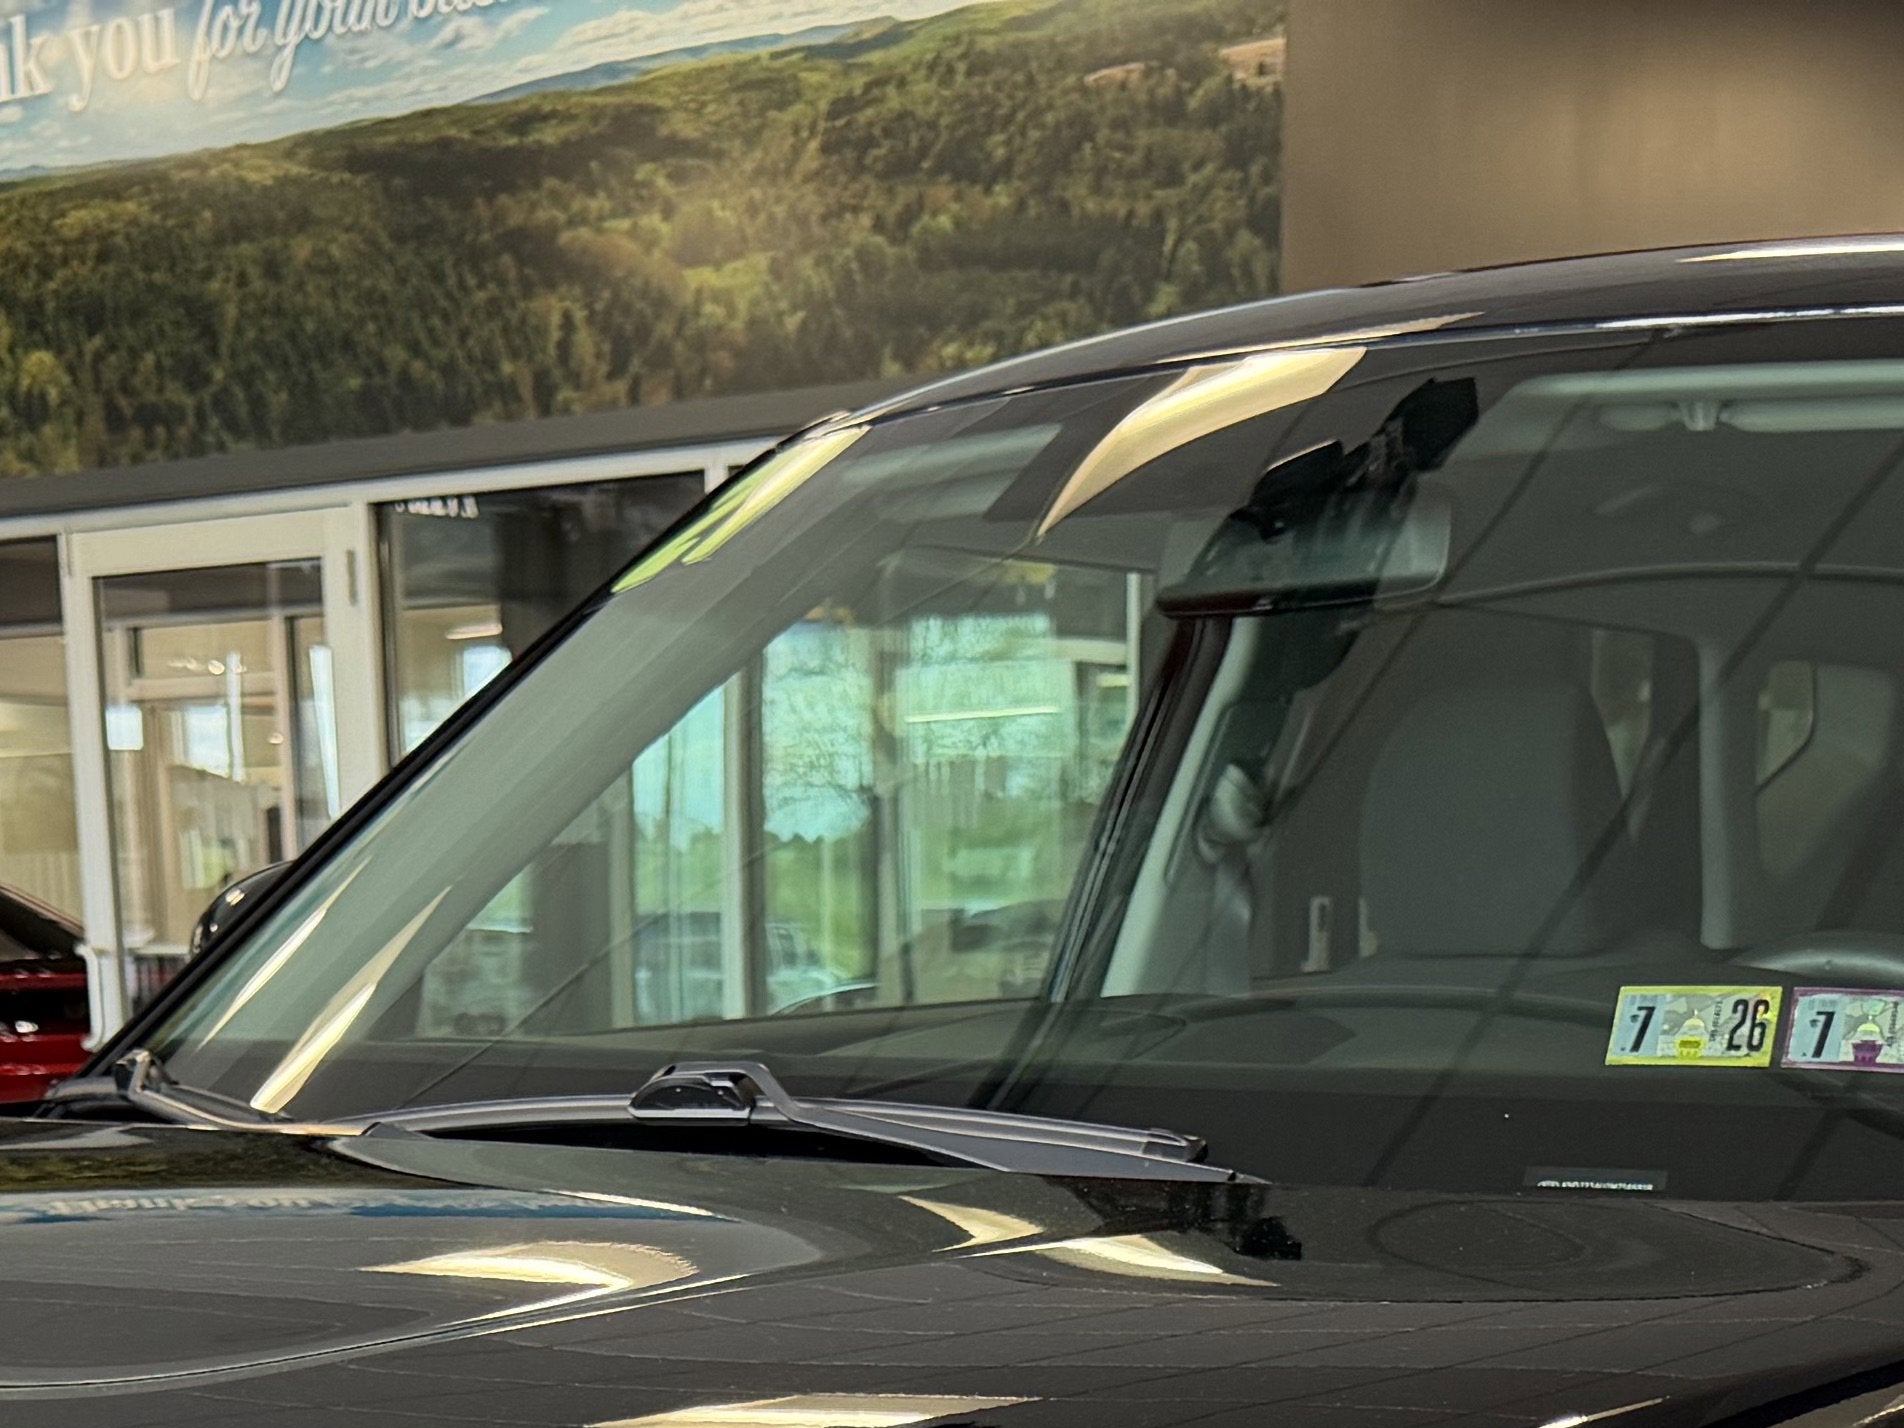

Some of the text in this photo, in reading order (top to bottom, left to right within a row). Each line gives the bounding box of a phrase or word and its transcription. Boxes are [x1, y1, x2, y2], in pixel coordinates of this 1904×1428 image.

[70, 7, 179, 111] you
[188, 0, 267, 100] for
[1629, 1006, 1657, 1053] 7
[1726, 998, 1771, 1053] 26
[1811, 1010, 1837, 1059] 7
